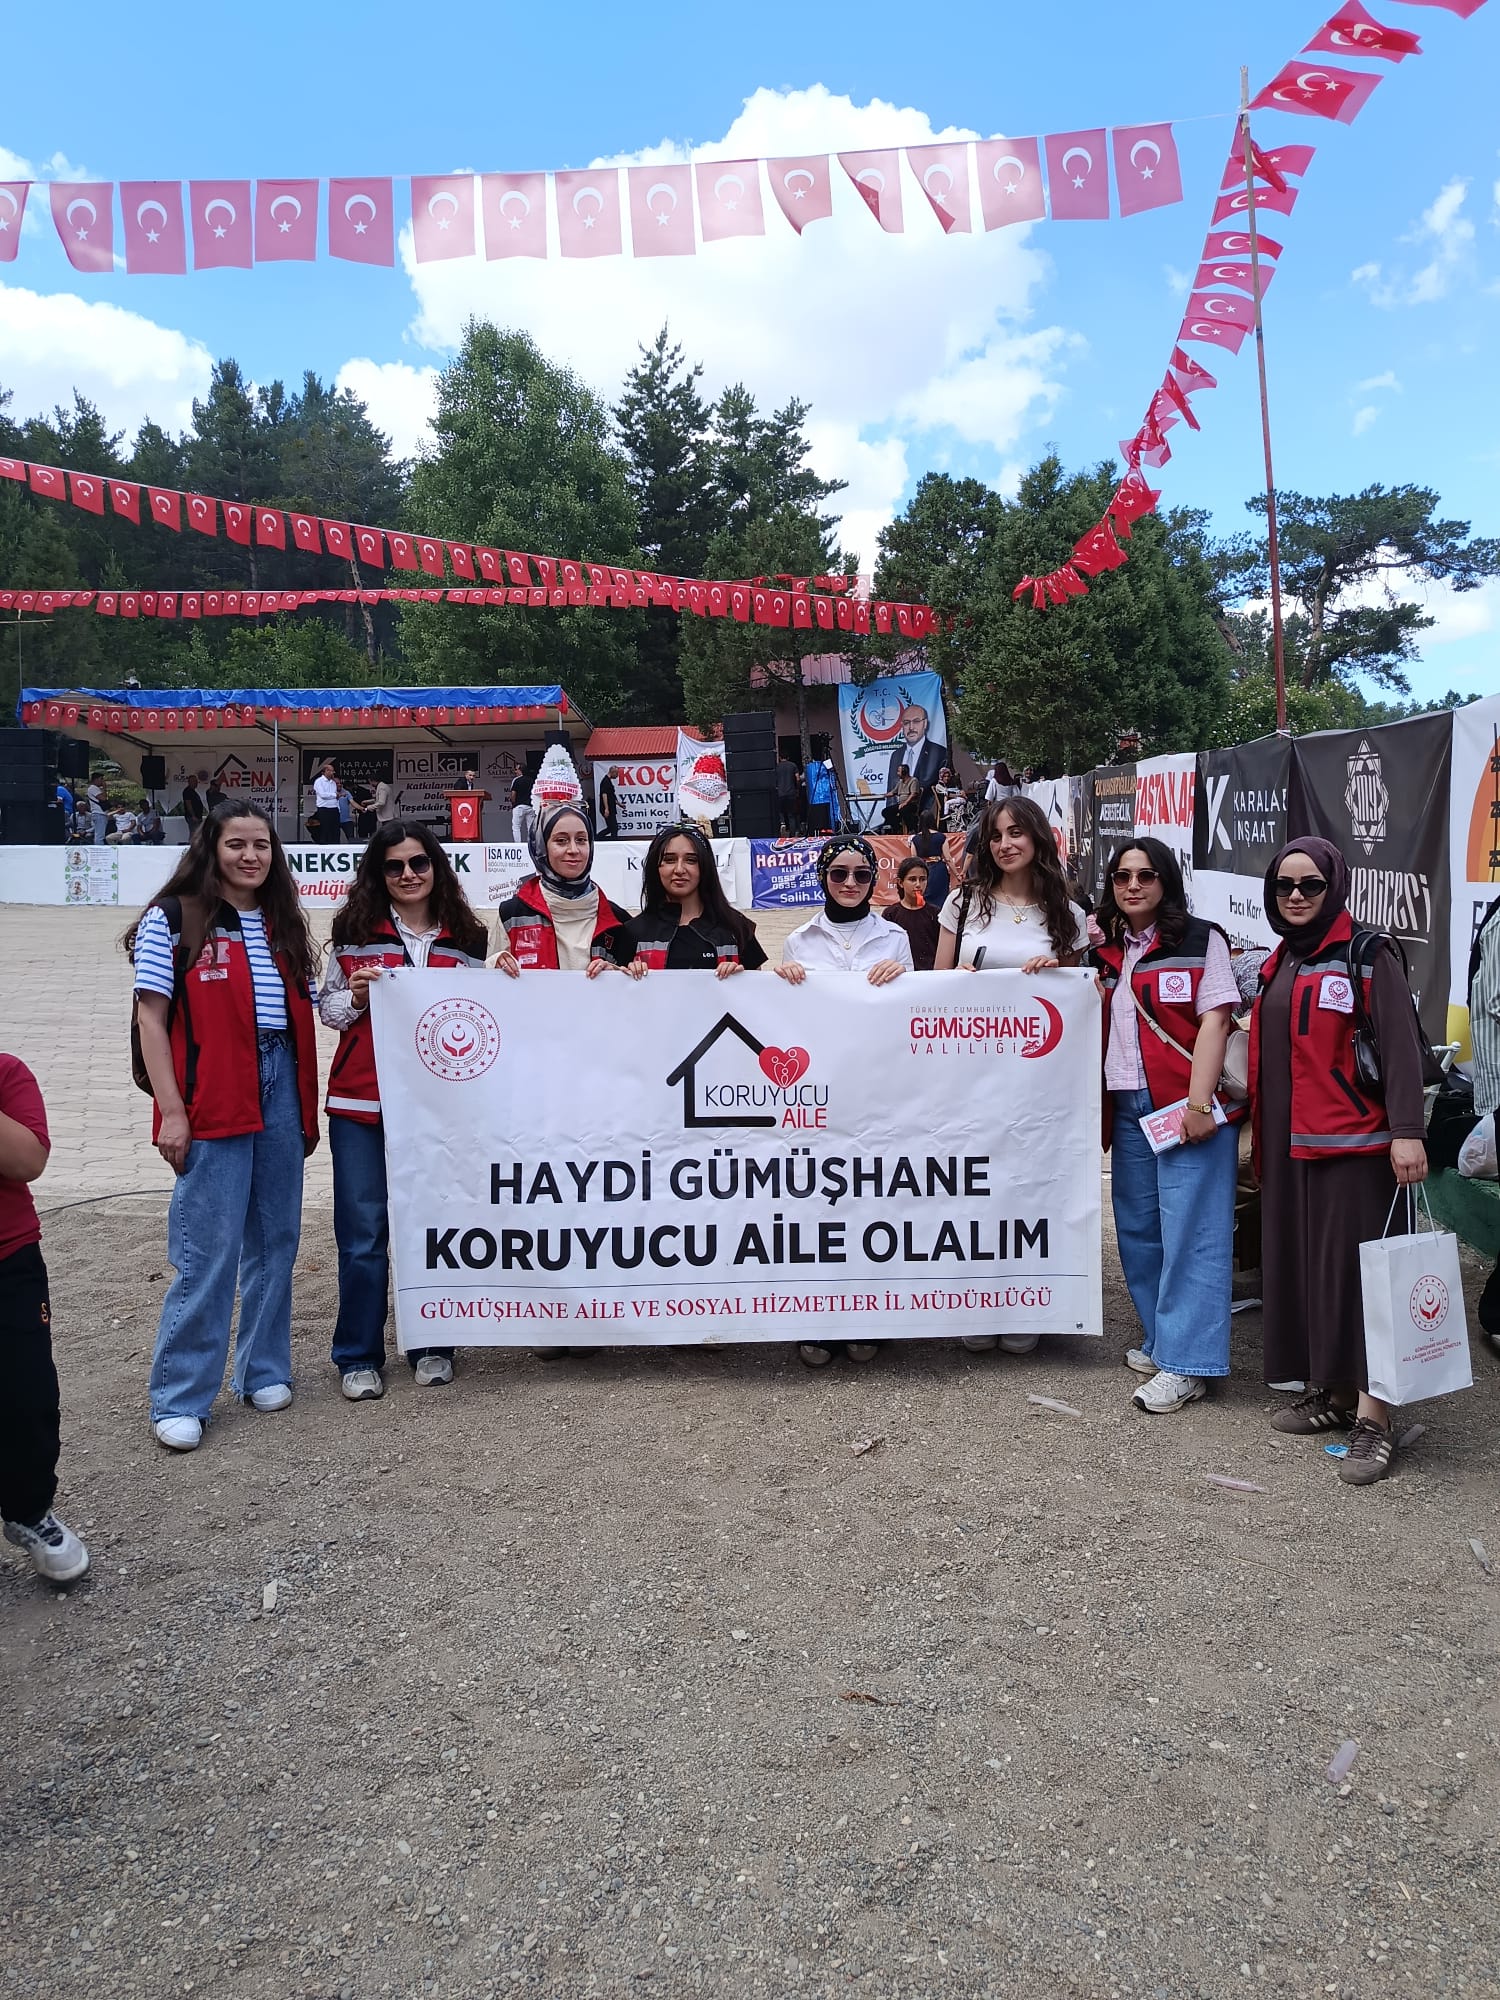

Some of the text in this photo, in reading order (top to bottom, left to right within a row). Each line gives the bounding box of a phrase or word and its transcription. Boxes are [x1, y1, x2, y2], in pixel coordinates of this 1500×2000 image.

[219, 770, 276, 788] ARENA
[618, 765, 673, 791] KOÇ
[401, 803, 445, 813] Teşekkür
[621, 808, 670, 819] Sami Koç
[636, 821, 653, 830] 310
[1233, 815, 1276, 848] İNŞAAT
[488, 847, 522, 862] İSA KOÇ
[756, 852, 803, 869] HAZIR
[780, 892, 810, 903] Salih
[910, 1005, 1017, 1014] TÜRKİYE CUMHURİYETİ
[911, 1016, 1041, 1042] GÜMÜŞHANE
[910, 1039, 1016, 1055] VALİLİĞİ
[705, 1085, 829, 1107] KORUYUCU
[781, 1103, 827, 1129] AİLE
[490, 1148, 991, 1207] HAYDİ GÜMÜŞHANE
[426, 1213, 1049, 1271] KORUYUCU AİLE OLALIM
[420, 1286, 1053, 1323] GÜMÜŞHANE AİLE VE SOSYAL HİZMETLER İL MÜDÜRLÜĞÜ
